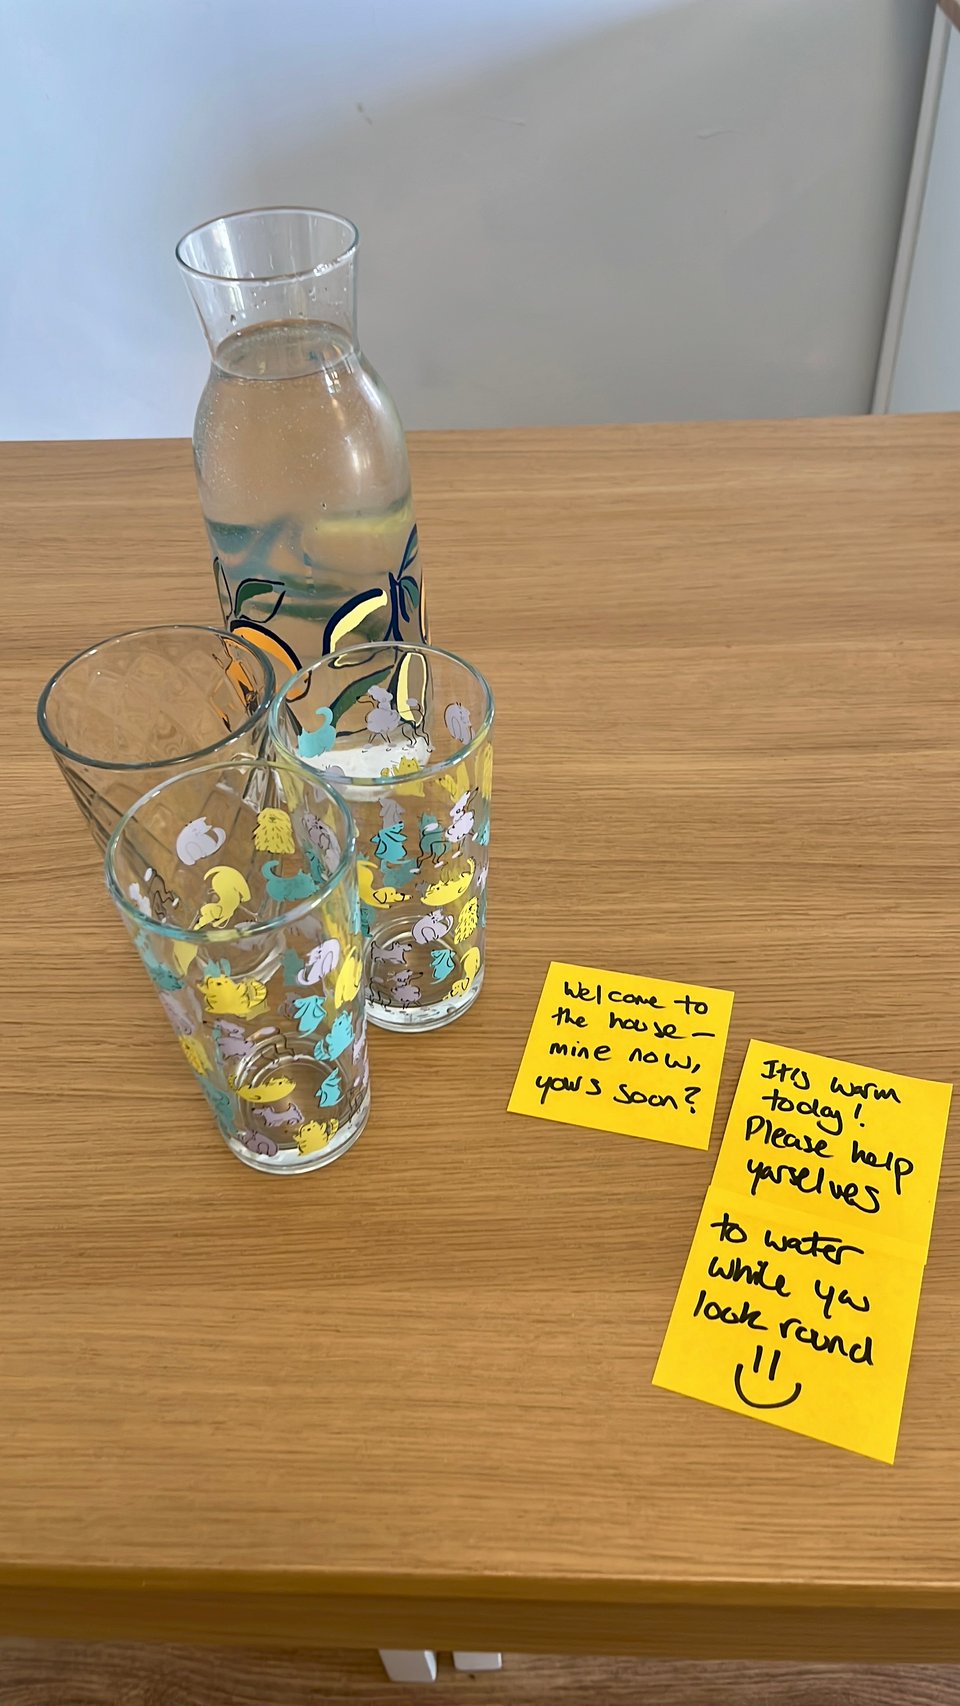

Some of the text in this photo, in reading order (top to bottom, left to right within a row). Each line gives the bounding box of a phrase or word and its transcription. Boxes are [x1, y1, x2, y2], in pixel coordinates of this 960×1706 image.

[565, 982, 708, 1014] Welcome to
[552, 1007, 588, 1027] the
[550, 1041, 700, 1073] mine now,
[613, 1084, 701, 1114] soon?
[830, 1077, 900, 1103] warm
[746, 1116, 913, 1195] Please help
[711, 1213, 864, 1265] to water
[708, 1257, 869, 1319] while you
[694, 1290, 873, 1365] look round
